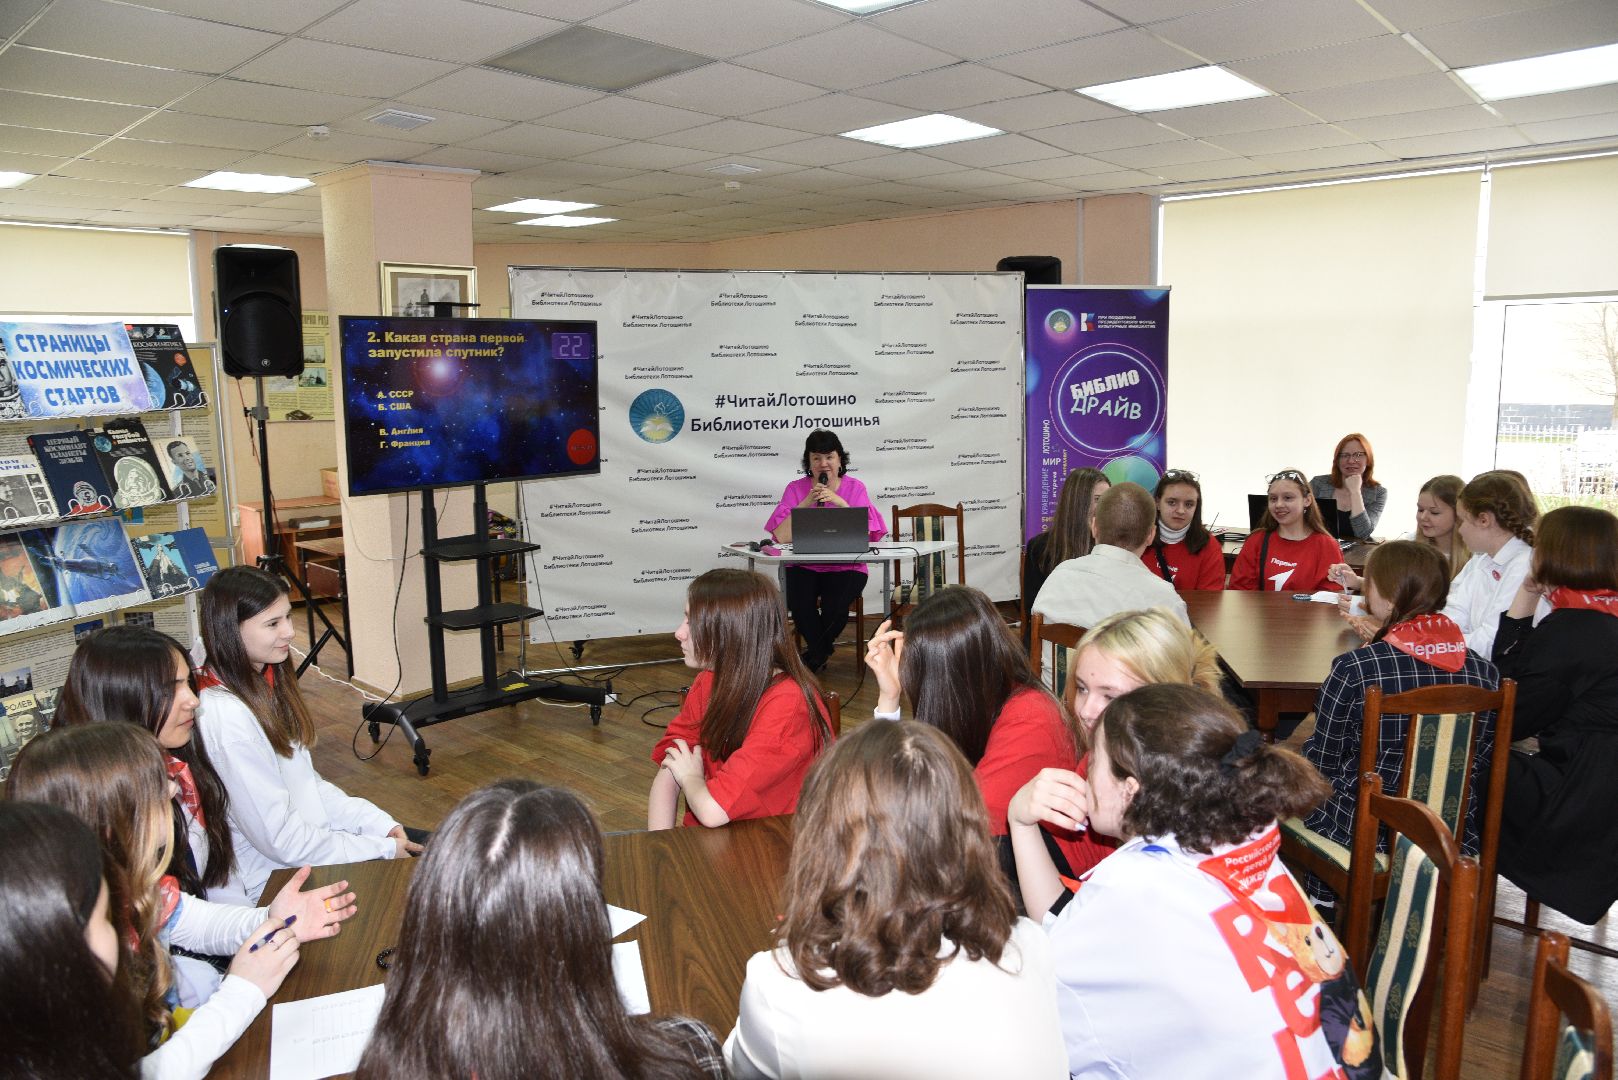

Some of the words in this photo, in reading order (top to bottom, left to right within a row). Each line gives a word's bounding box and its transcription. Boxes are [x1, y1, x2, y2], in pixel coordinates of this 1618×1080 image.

[15, 333, 111, 355] СТРАНИЦЫ
[368, 332, 380, 343] 2.
[384, 332, 426, 344] Какая
[430, 333, 476, 346] страна
[480, 332, 524, 344] первой
[559, 336, 583, 356] 22
[368, 348, 442, 360] запустила
[446, 346, 504, 360] спутник?
[12, 357, 134, 380] КОСМИЧЕСКИХ
[1070, 369, 1140, 400] БИБЛИО
[44, 385, 121, 407] СТАРТОВ
[378, 391, 387, 399] А.
[388, 390, 414, 399] СССР
[715, 393, 856, 408] #ЧитайЛотошино
[378, 403, 388, 411] Б.
[389, 402, 412, 411] США
[1070, 395, 1142, 420] ДРАЙВ
[380, 428, 390, 436] В.
[391, 427, 424, 436] Англия
[691, 418, 788, 432] Библиотеки
[792, 416, 880, 429] Лотошинья
[380, 440, 389, 448] Г.
[390, 439, 430, 449] Франция
[1042, 458, 1061, 466] МИР
